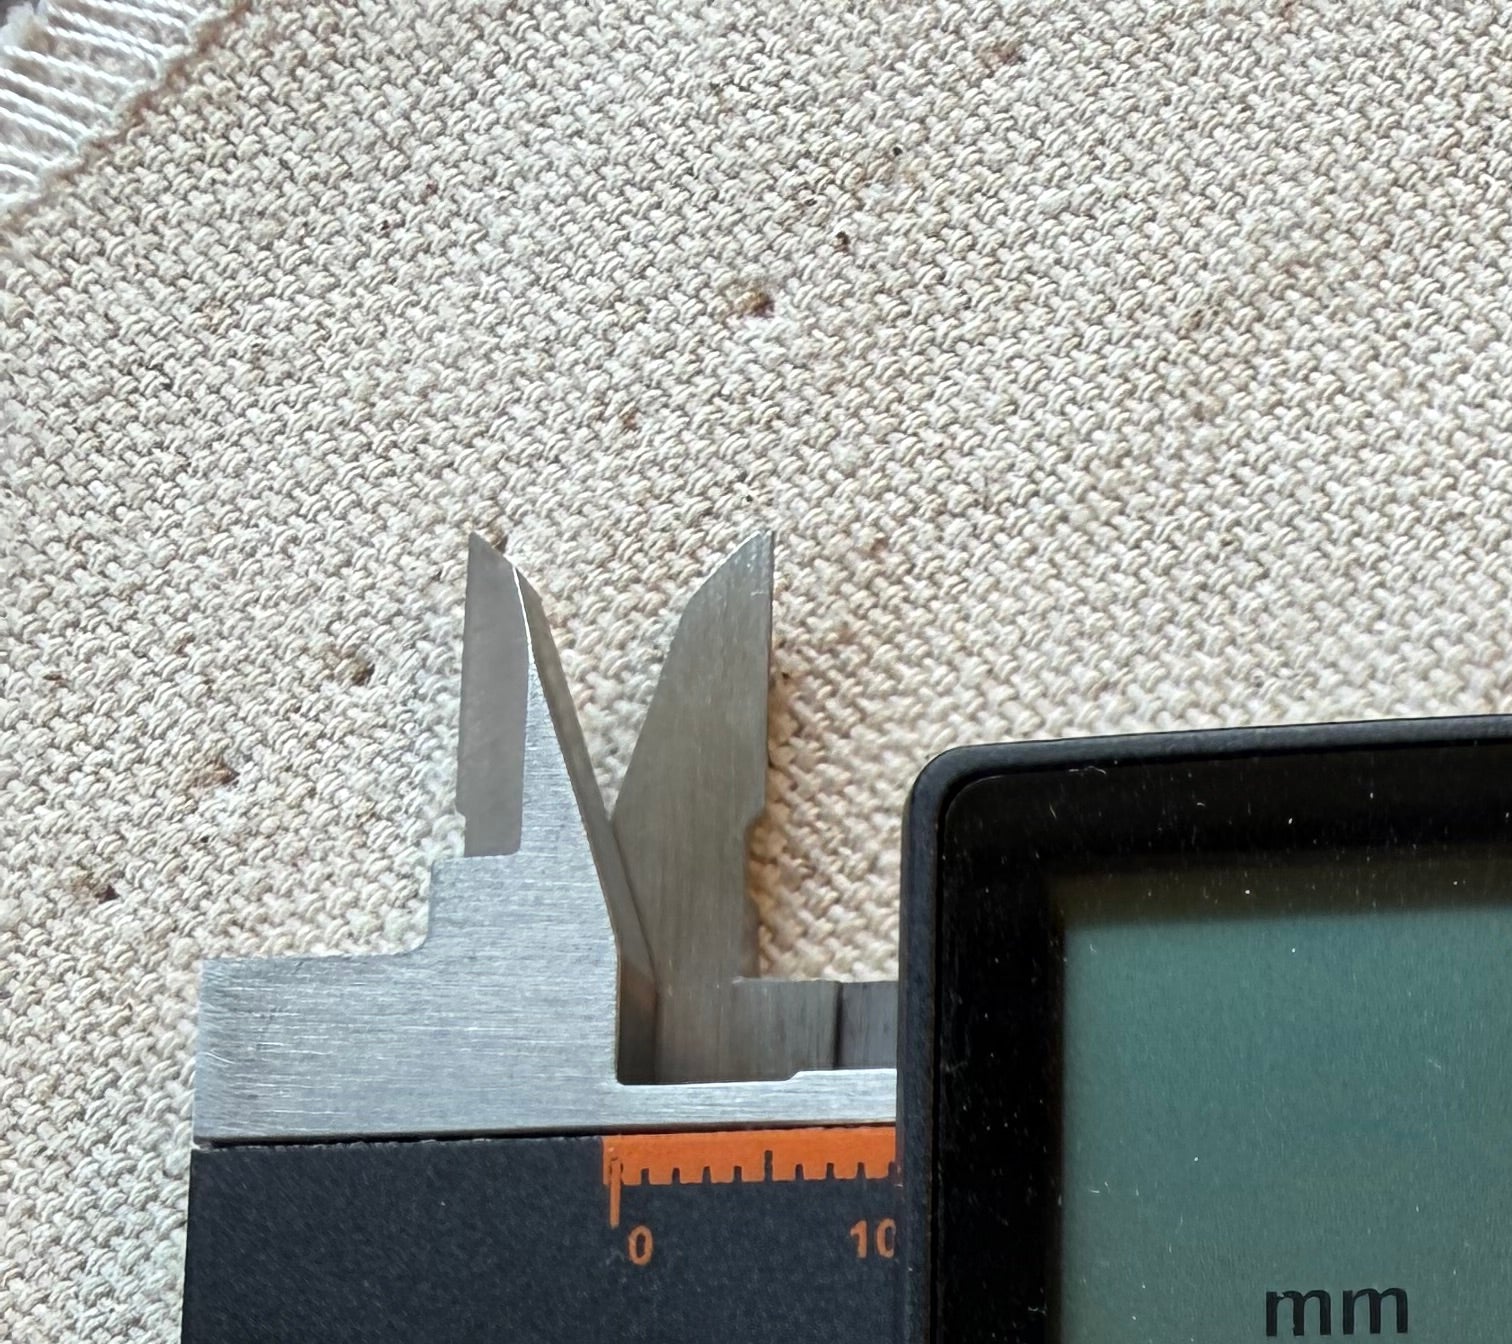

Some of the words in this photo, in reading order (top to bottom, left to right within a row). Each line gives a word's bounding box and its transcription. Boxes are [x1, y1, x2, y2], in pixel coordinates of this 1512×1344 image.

[628, 1226, 653, 1265] 0
[850, 1218, 896, 1258] 10
[1265, 1286, 1410, 1338] mm
